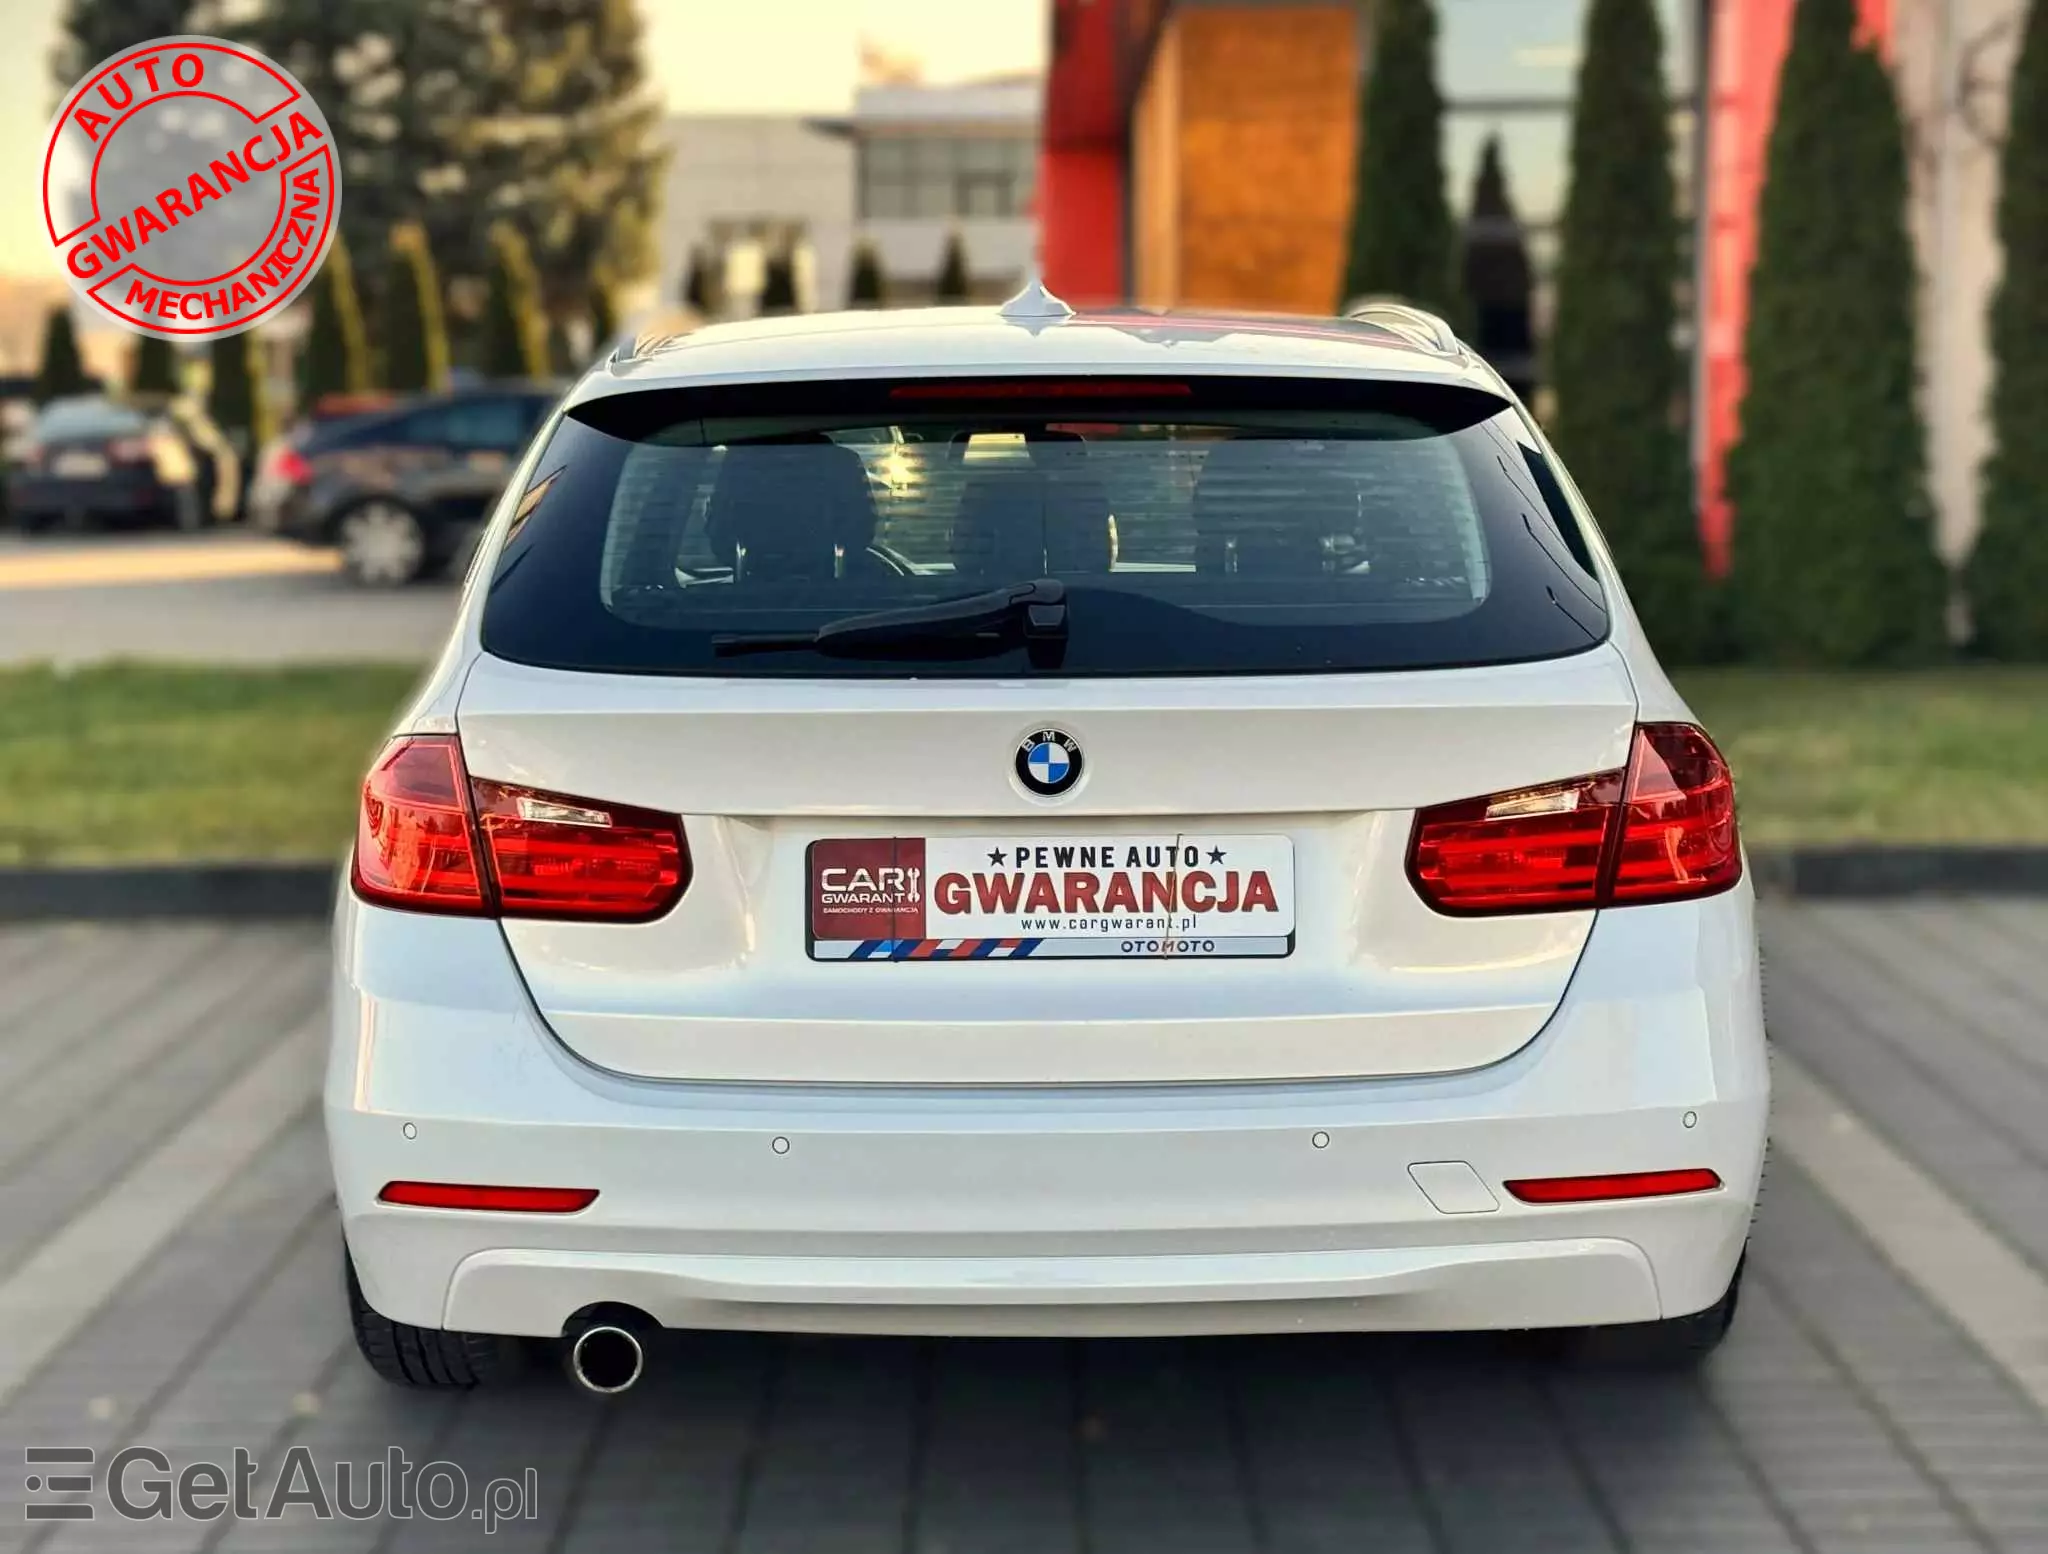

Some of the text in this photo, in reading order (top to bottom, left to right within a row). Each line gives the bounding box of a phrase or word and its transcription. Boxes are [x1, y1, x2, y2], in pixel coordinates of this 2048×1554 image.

[1021, 731, 1077, 753] BMW
[1015, 845, 1199, 868] PEWNE AUTO
[821, 867, 905, 891] CAR
[821, 893, 905, 903] GWARANT
[934, 871, 1279, 915] GWARANCJA
[1021, 914, 1196, 932] www.cargwarant.pl
[1121, 940, 1215, 953] OTOMOTO
